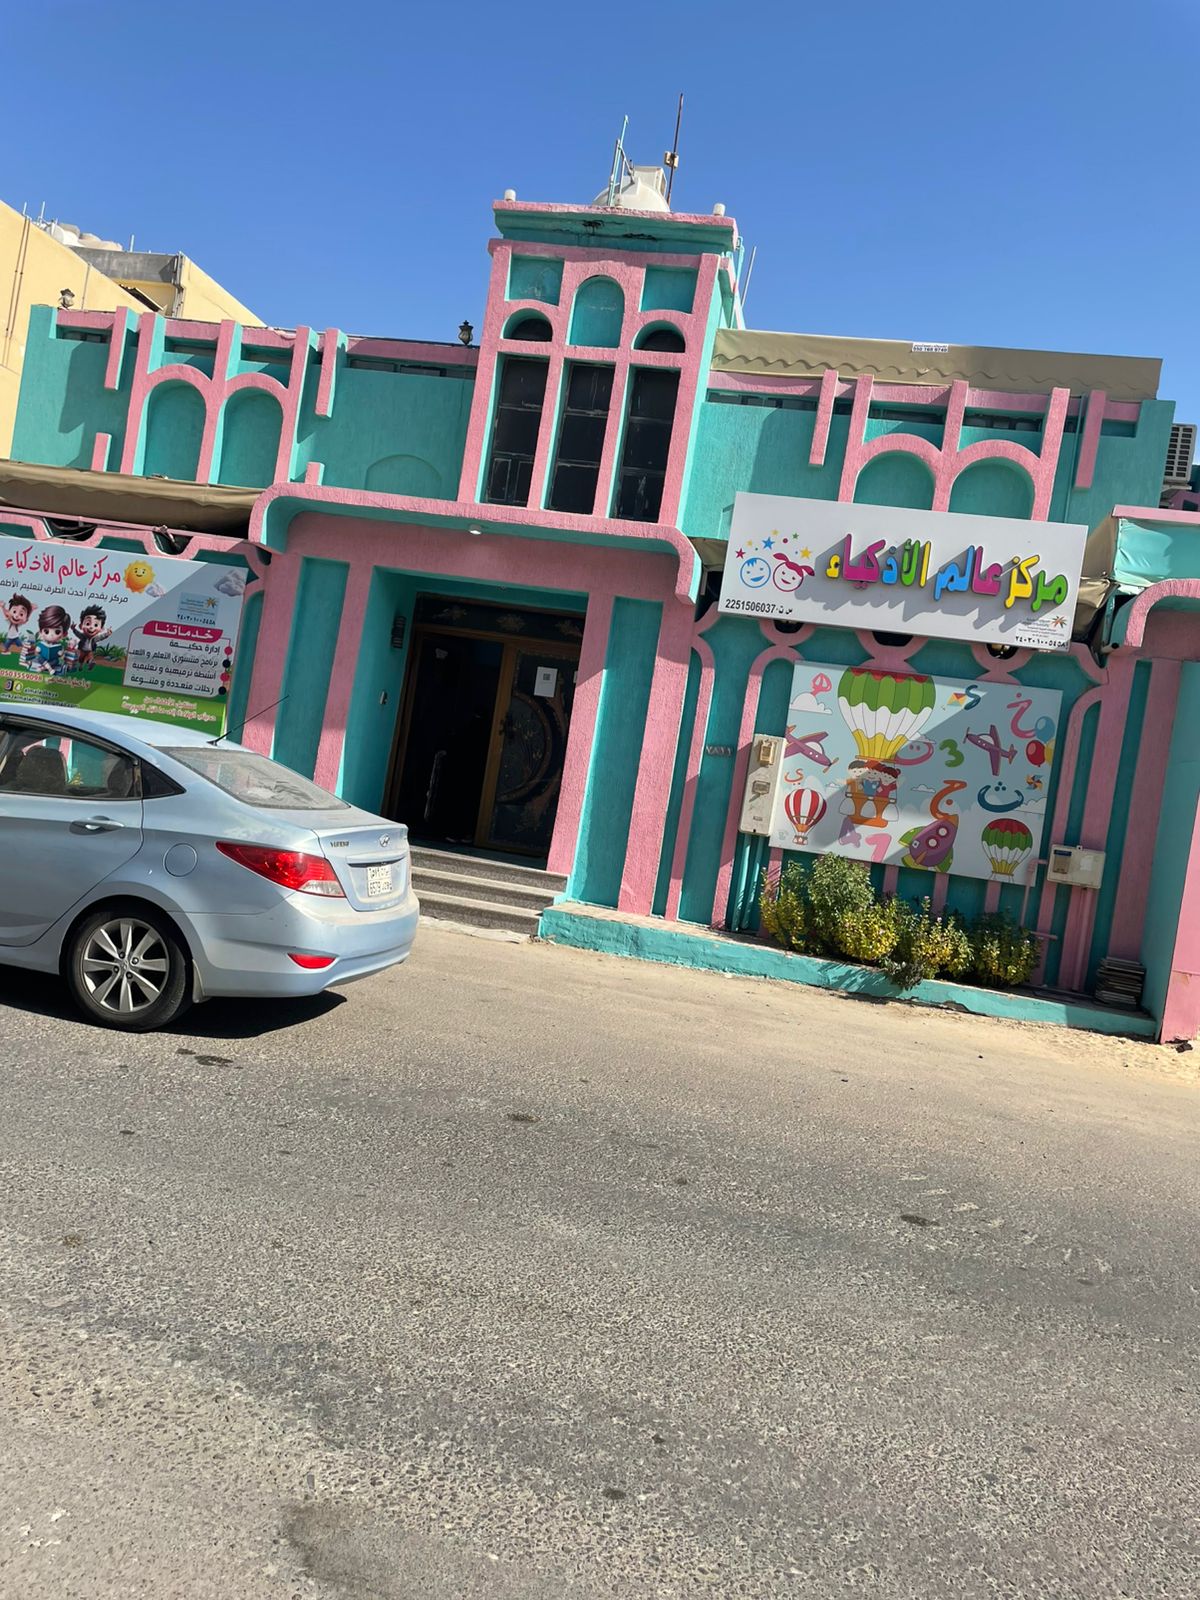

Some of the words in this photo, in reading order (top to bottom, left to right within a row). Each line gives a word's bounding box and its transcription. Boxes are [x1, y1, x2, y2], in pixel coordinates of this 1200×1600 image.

[5, 545, 54, 573] الأذكياء
[825, 533, 931, 590] الأذكياء
[58, 558, 88, 585] عالم
[88, 555, 121, 587] مركز
[933, 545, 1003, 601] عالم
[0, 577, 19, 588] الأطف
[20, 582, 43, 592] لتعليم
[1003, 554, 1068, 612] مركز
[88, 591, 108, 601] يقدم
[109, 592, 129, 604] مركز
[725, 599, 776, 613] 2251506037
[154, 623, 214, 639] خدماتنا
[205, 645, 220, 656] إدارة
[166, 680, 193, 690] متعددة
[194, 684, 214, 694] رحلات
[939, 738, 965, 768] 3
[977, 781, 1024, 813] ث
